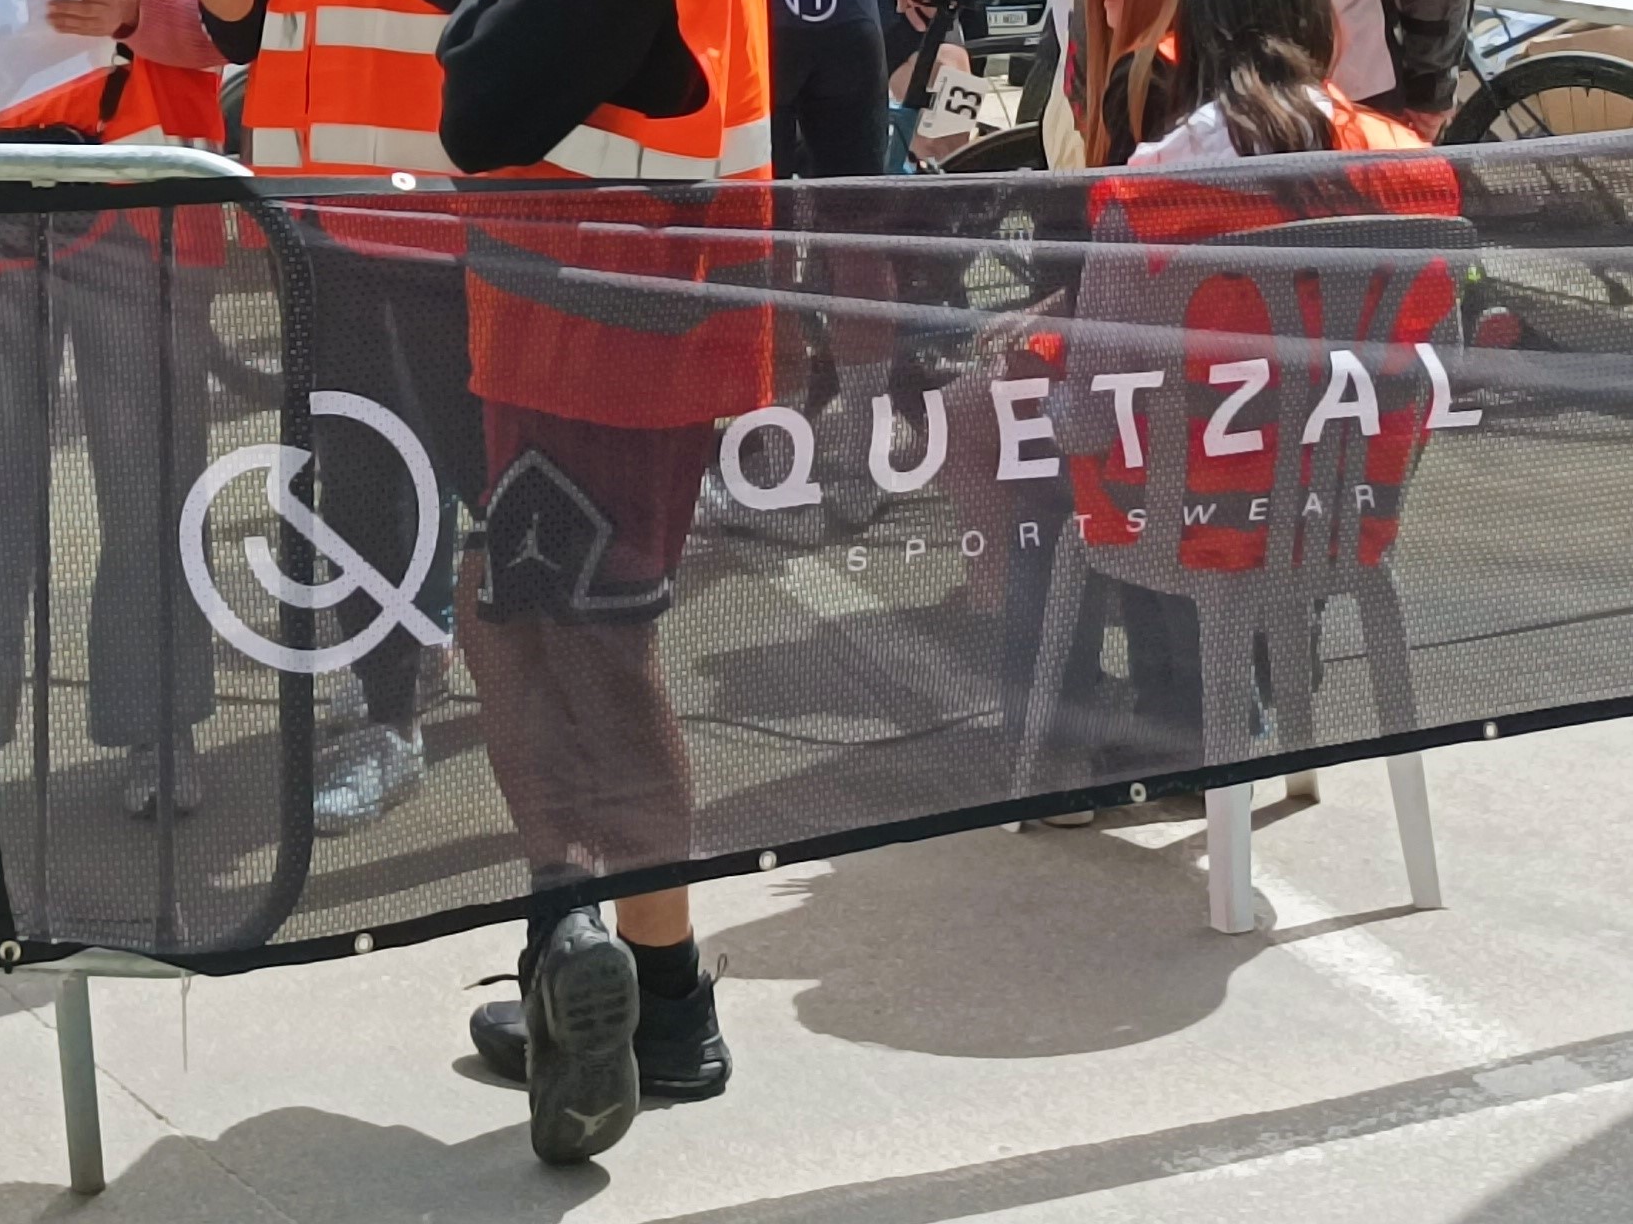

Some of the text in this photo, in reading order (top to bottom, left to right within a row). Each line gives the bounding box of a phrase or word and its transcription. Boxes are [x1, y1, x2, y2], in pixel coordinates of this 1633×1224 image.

[944, 85, 983, 121] 53
[718, 342, 1483, 511] QUETZAL
[847, 484, 1377, 573] SPORTSWEAR
